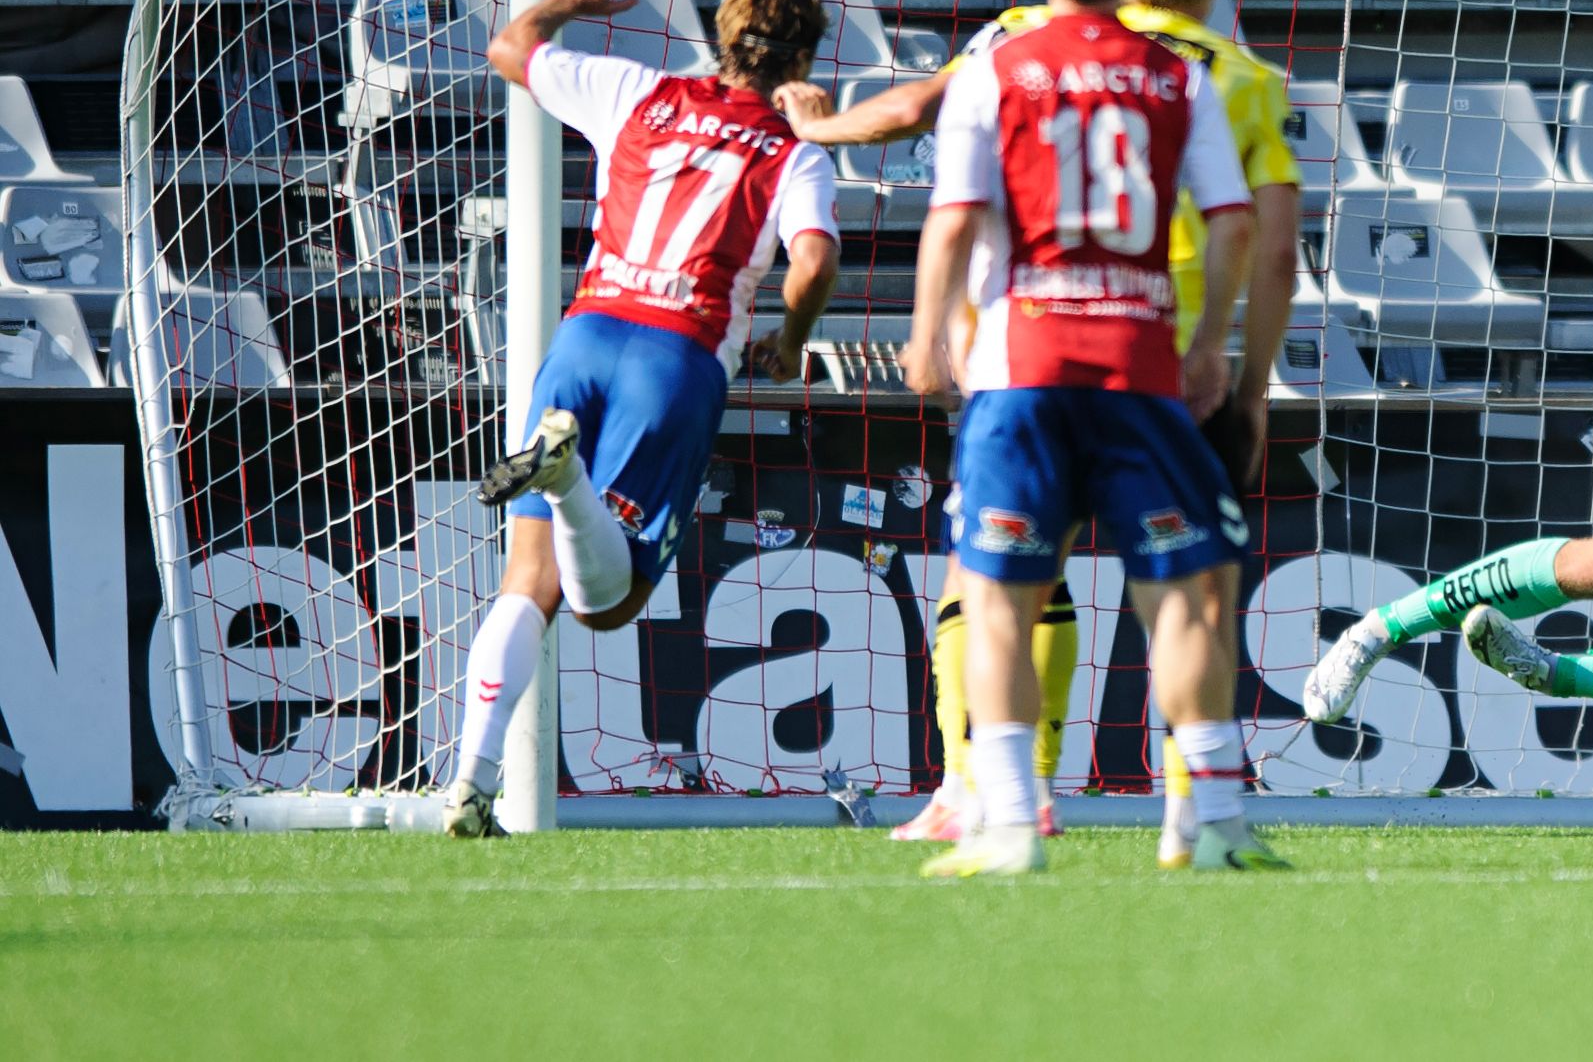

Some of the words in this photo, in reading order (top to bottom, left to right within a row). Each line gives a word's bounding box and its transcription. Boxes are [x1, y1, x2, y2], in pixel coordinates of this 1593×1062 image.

[1057, 61, 1179, 102] ARCTIC
[677, 111, 784, 156] ARCTIC
[625, 140, 747, 273] 17
[1037, 104, 1158, 256] 18
[1443, 557, 1519, 614] RECTO
